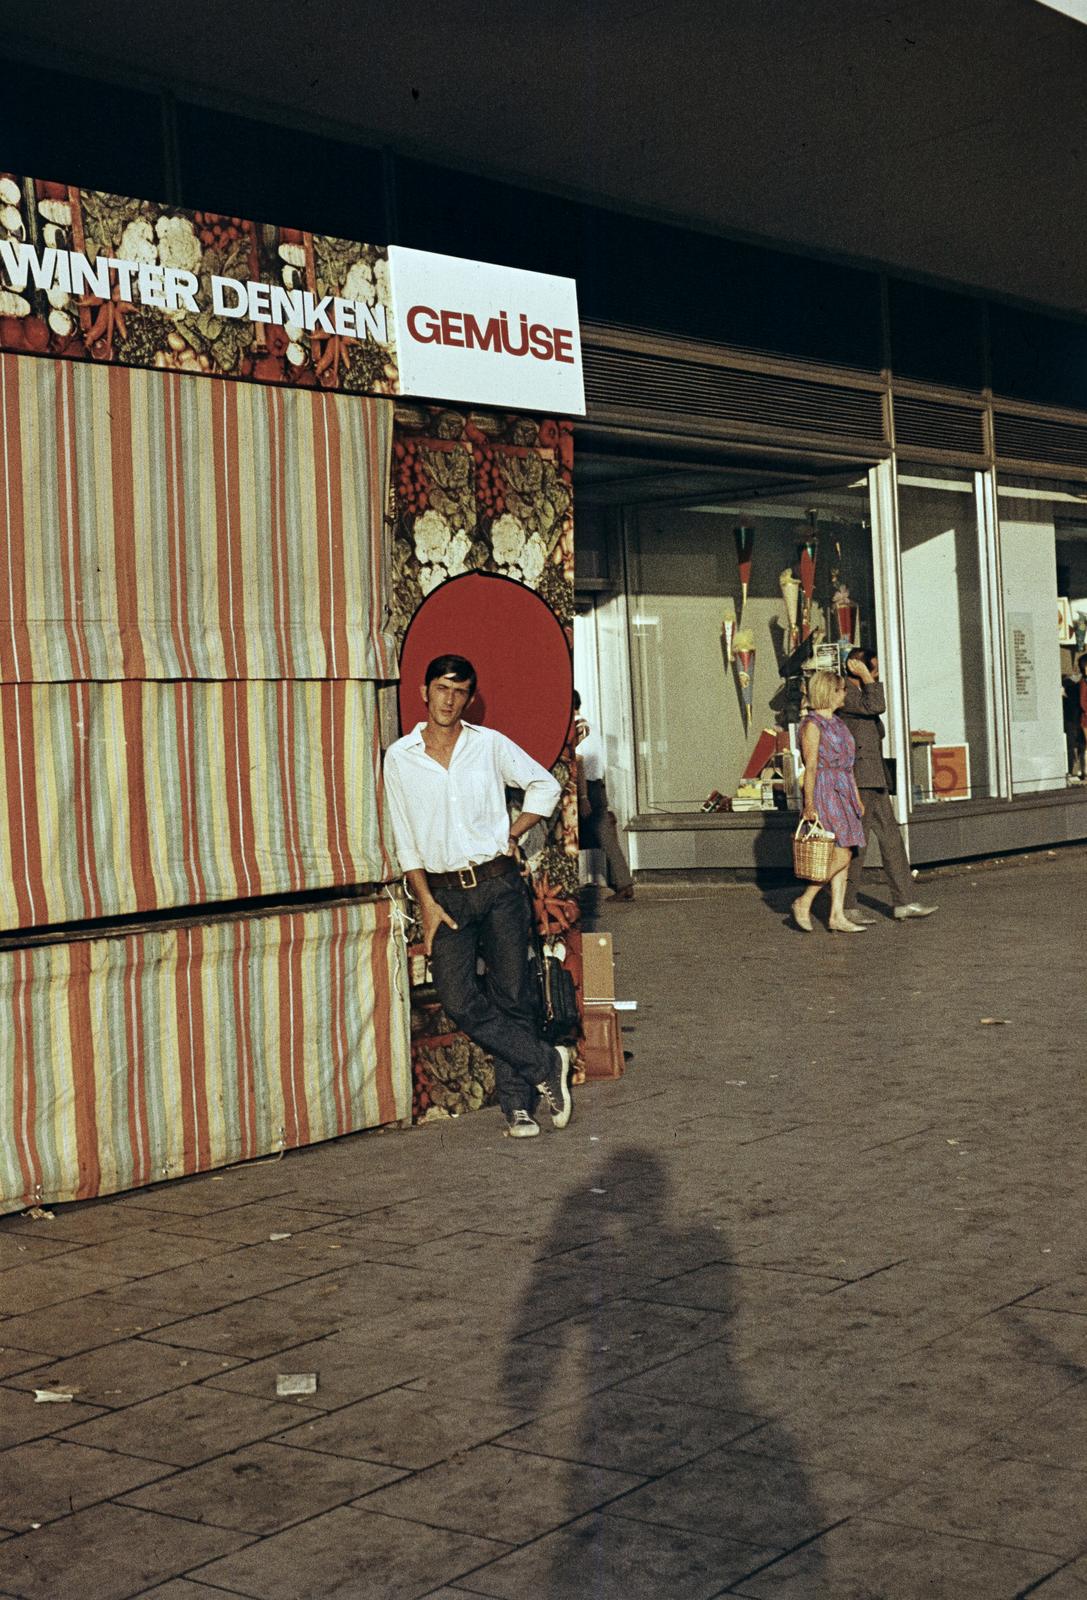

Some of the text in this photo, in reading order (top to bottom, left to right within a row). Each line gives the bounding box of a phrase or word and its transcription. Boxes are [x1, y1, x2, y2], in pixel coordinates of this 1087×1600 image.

[0, 240, 389, 342] WINTER DENKEN
[406, 305, 575, 364] GEMÜSE
